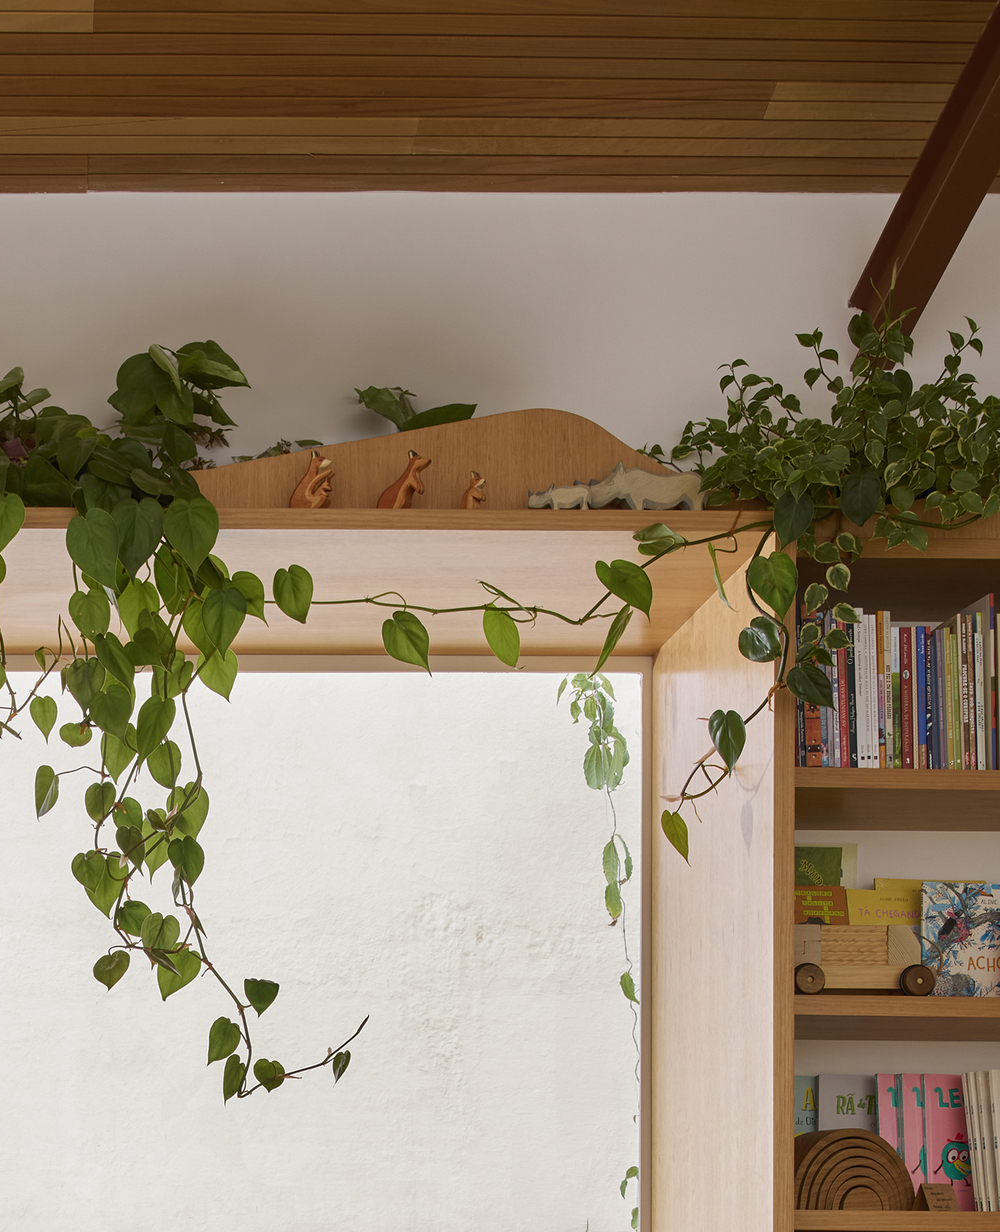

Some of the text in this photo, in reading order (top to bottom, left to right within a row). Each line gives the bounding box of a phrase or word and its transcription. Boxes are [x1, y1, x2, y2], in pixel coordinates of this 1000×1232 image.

[858, 906, 871, 917] TÁ
[801, 1087, 816, 1111] A
[836, 1093, 856, 1115] RÃ
